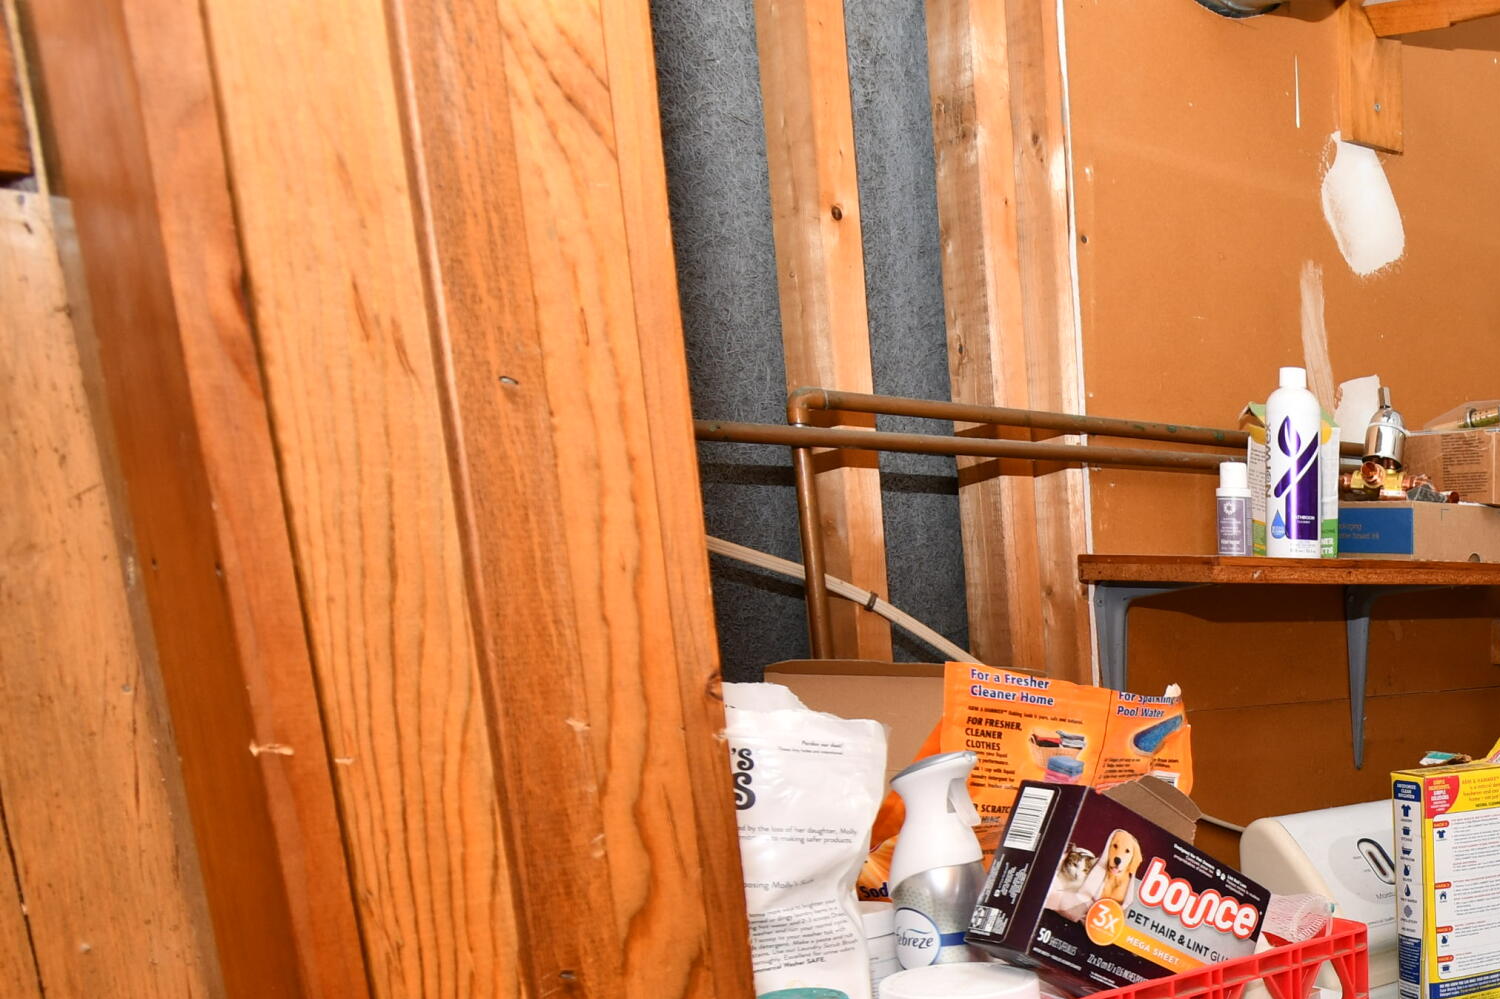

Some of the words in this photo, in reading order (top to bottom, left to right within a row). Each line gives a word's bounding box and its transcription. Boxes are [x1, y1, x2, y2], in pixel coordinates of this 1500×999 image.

[970, 668, 989, 681] For
[994, 673, 1001, 683] a
[1004, 674, 1050, 690] Fresher
[970, 685, 1016, 700] Cleaner
[1020, 691, 1054, 706] Home
[1117, 705, 1138, 717] Pool
[1140, 707, 1164, 718] Water
[966, 716, 982, 726] FOR
[965, 728, 1002, 740] CLEANER
[966, 739, 1001, 751] CLOTHES
[981, 804, 1011, 813] SCRATC
[860, 882, 889, 899] Sod
[1139, 857, 1259, 939] bounce
[1037, 927, 1051, 943] 50
[1127, 910, 1148, 927] PET
[1150, 919, 1177, 942] HAIR
[1177, 935, 1186, 947] &
[1186, 939, 1209, 957] LINT
[1126, 935, 1151, 954] MEGA
[1152, 948, 1179, 966] SHEET
